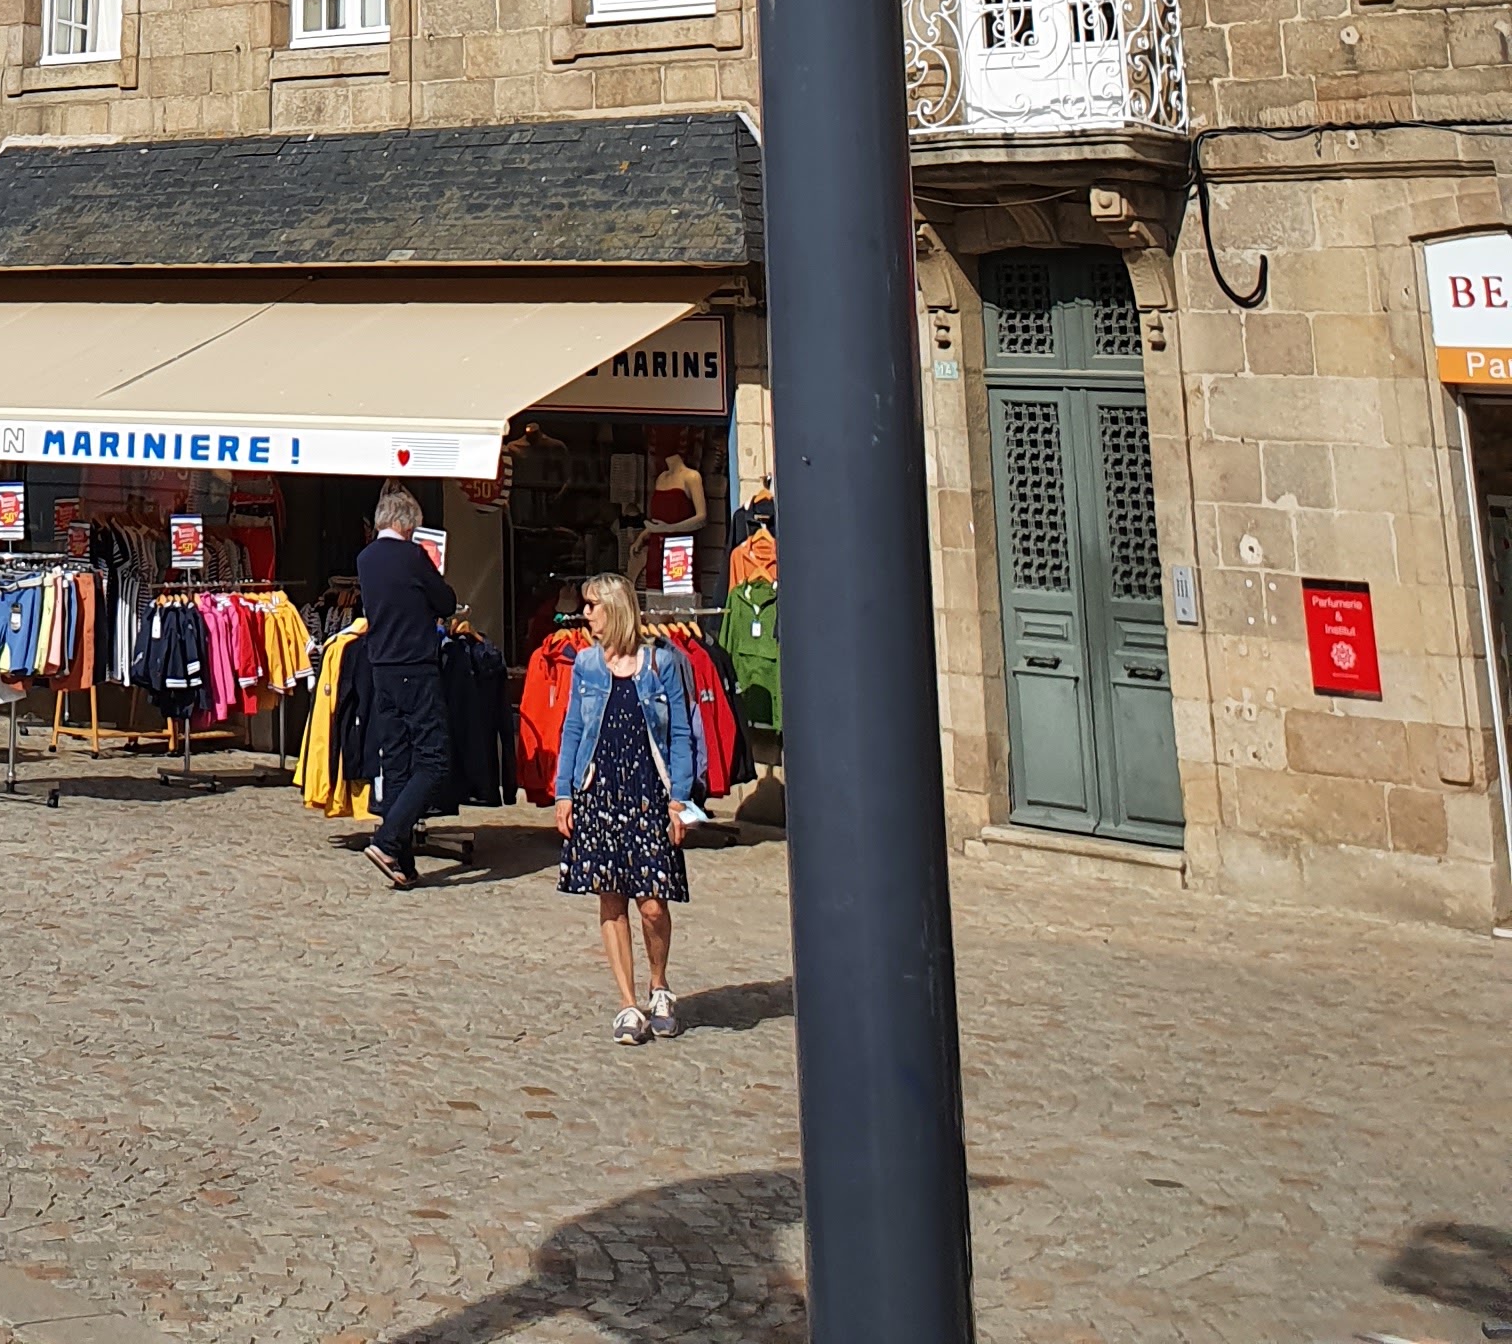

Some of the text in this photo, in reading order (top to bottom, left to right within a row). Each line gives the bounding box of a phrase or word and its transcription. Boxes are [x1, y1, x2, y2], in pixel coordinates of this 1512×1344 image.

[612, 351, 718, 378] MARINS
[42, 428, 271, 464] MARINIERE
[1311, 595, 1363, 611] Parfumerie
[1324, 623, 1356, 637] Institut
